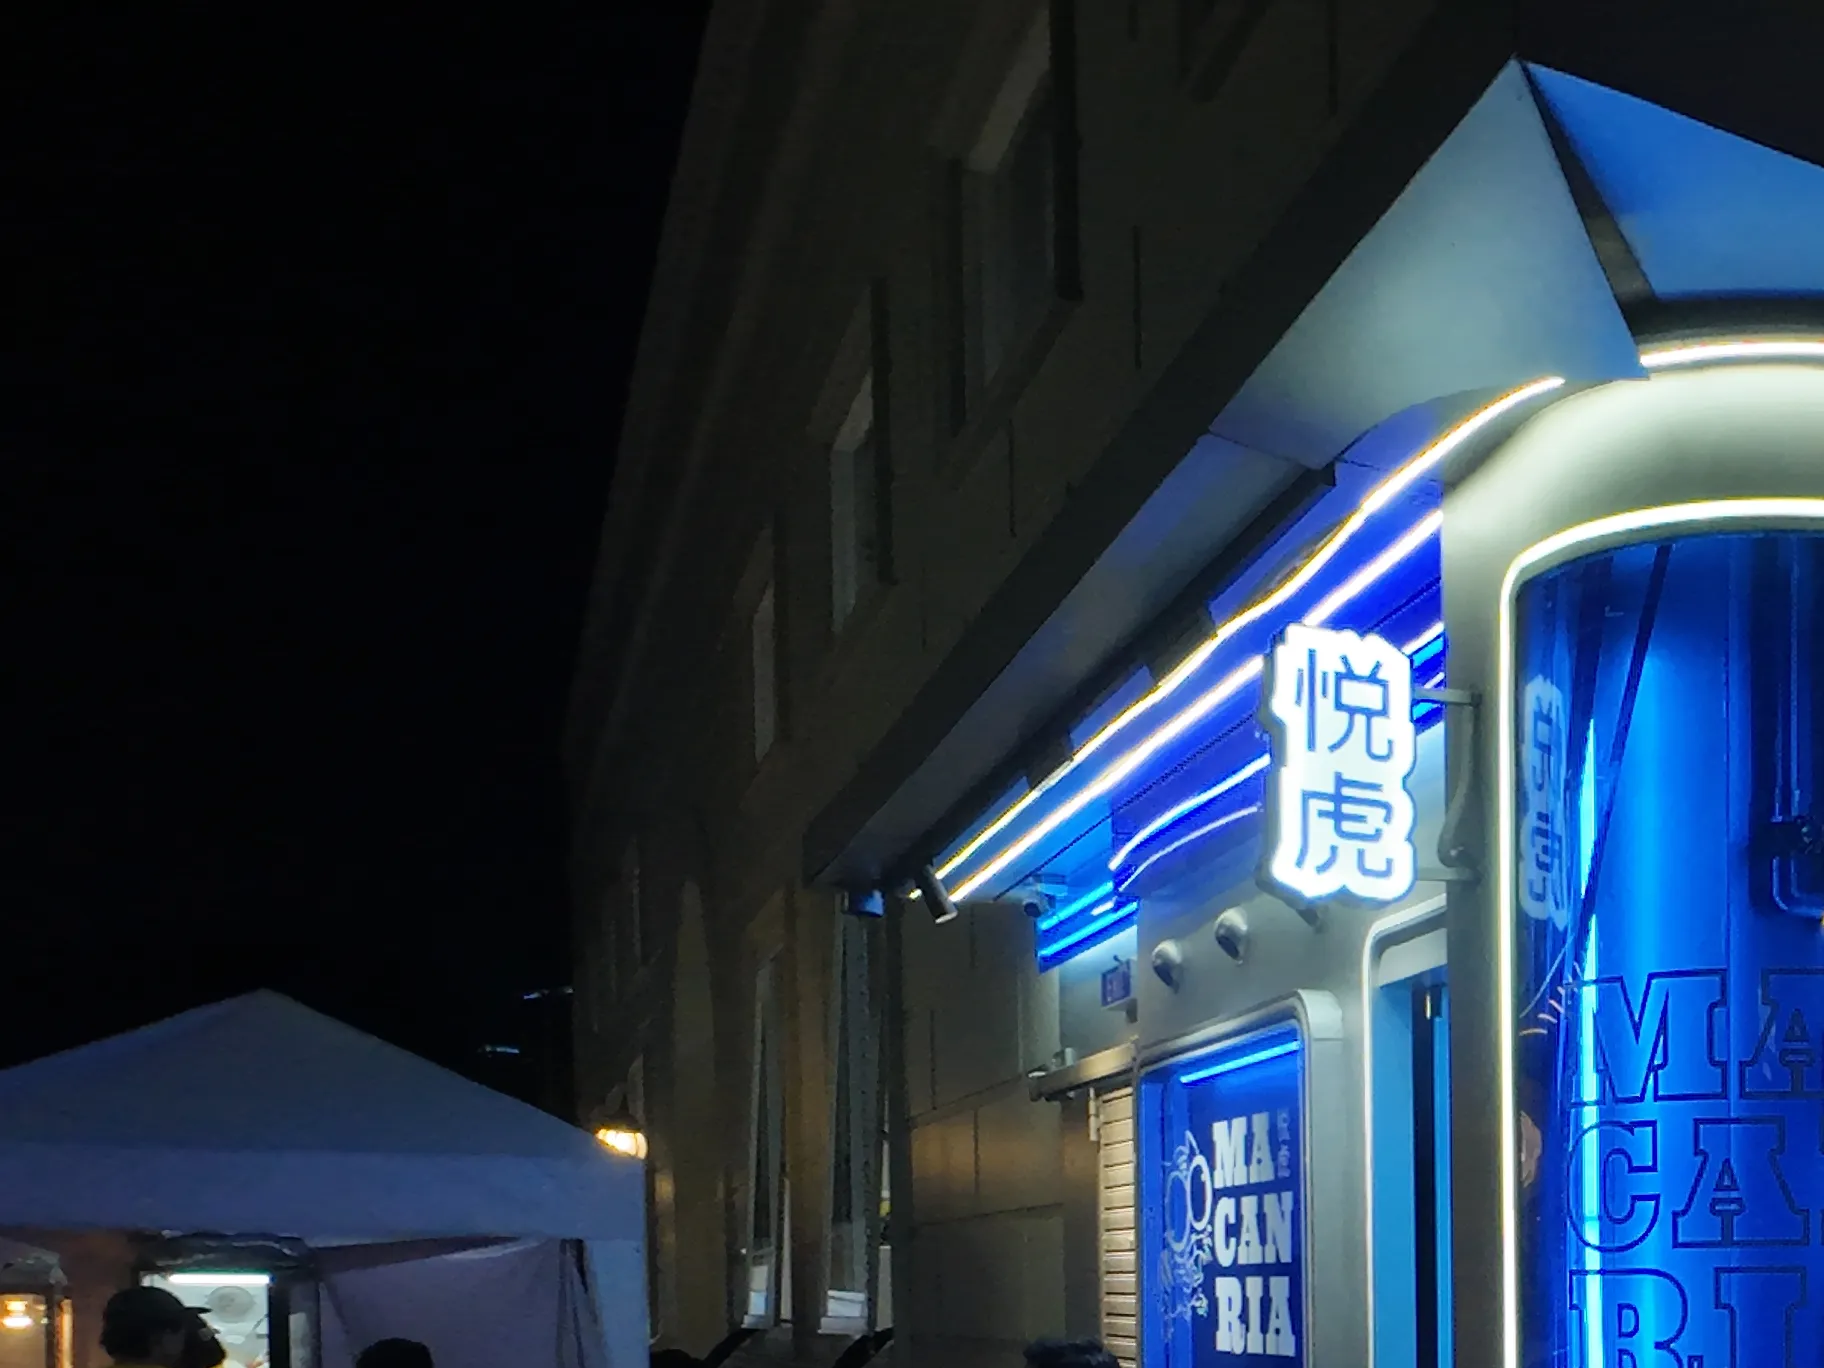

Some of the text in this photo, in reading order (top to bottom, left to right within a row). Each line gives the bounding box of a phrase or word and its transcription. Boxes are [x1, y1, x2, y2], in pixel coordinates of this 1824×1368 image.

[1294, 647, 1395, 879] 悦虎
[1211, 1111, 1275, 1188] MA
[1213, 1190, 1294, 1268] CAN
[1215, 1276, 1297, 1357] RIA
